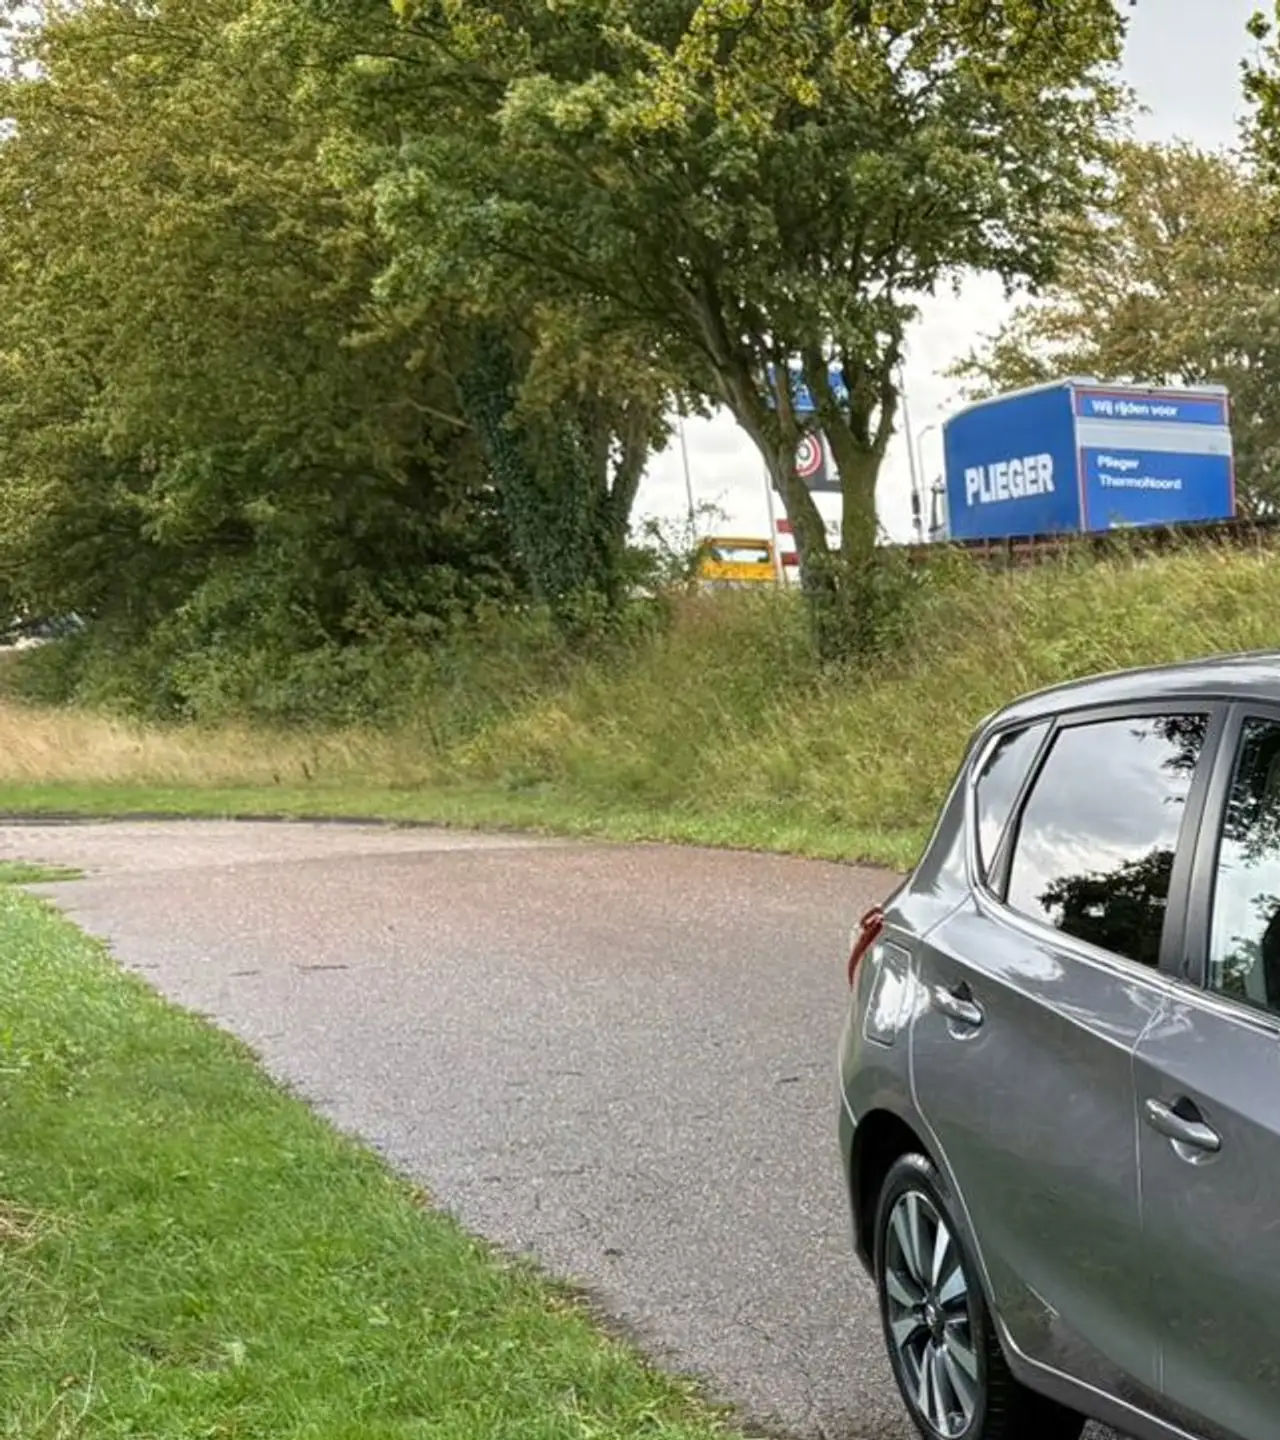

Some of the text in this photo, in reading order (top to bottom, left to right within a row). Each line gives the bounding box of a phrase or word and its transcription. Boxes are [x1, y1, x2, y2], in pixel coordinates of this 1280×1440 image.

[1091, 400, 1178, 417] Wij rijden voor
[1097, 455, 1139, 471] Plieger
[964, 453, 1055, 506] PLIEGER
